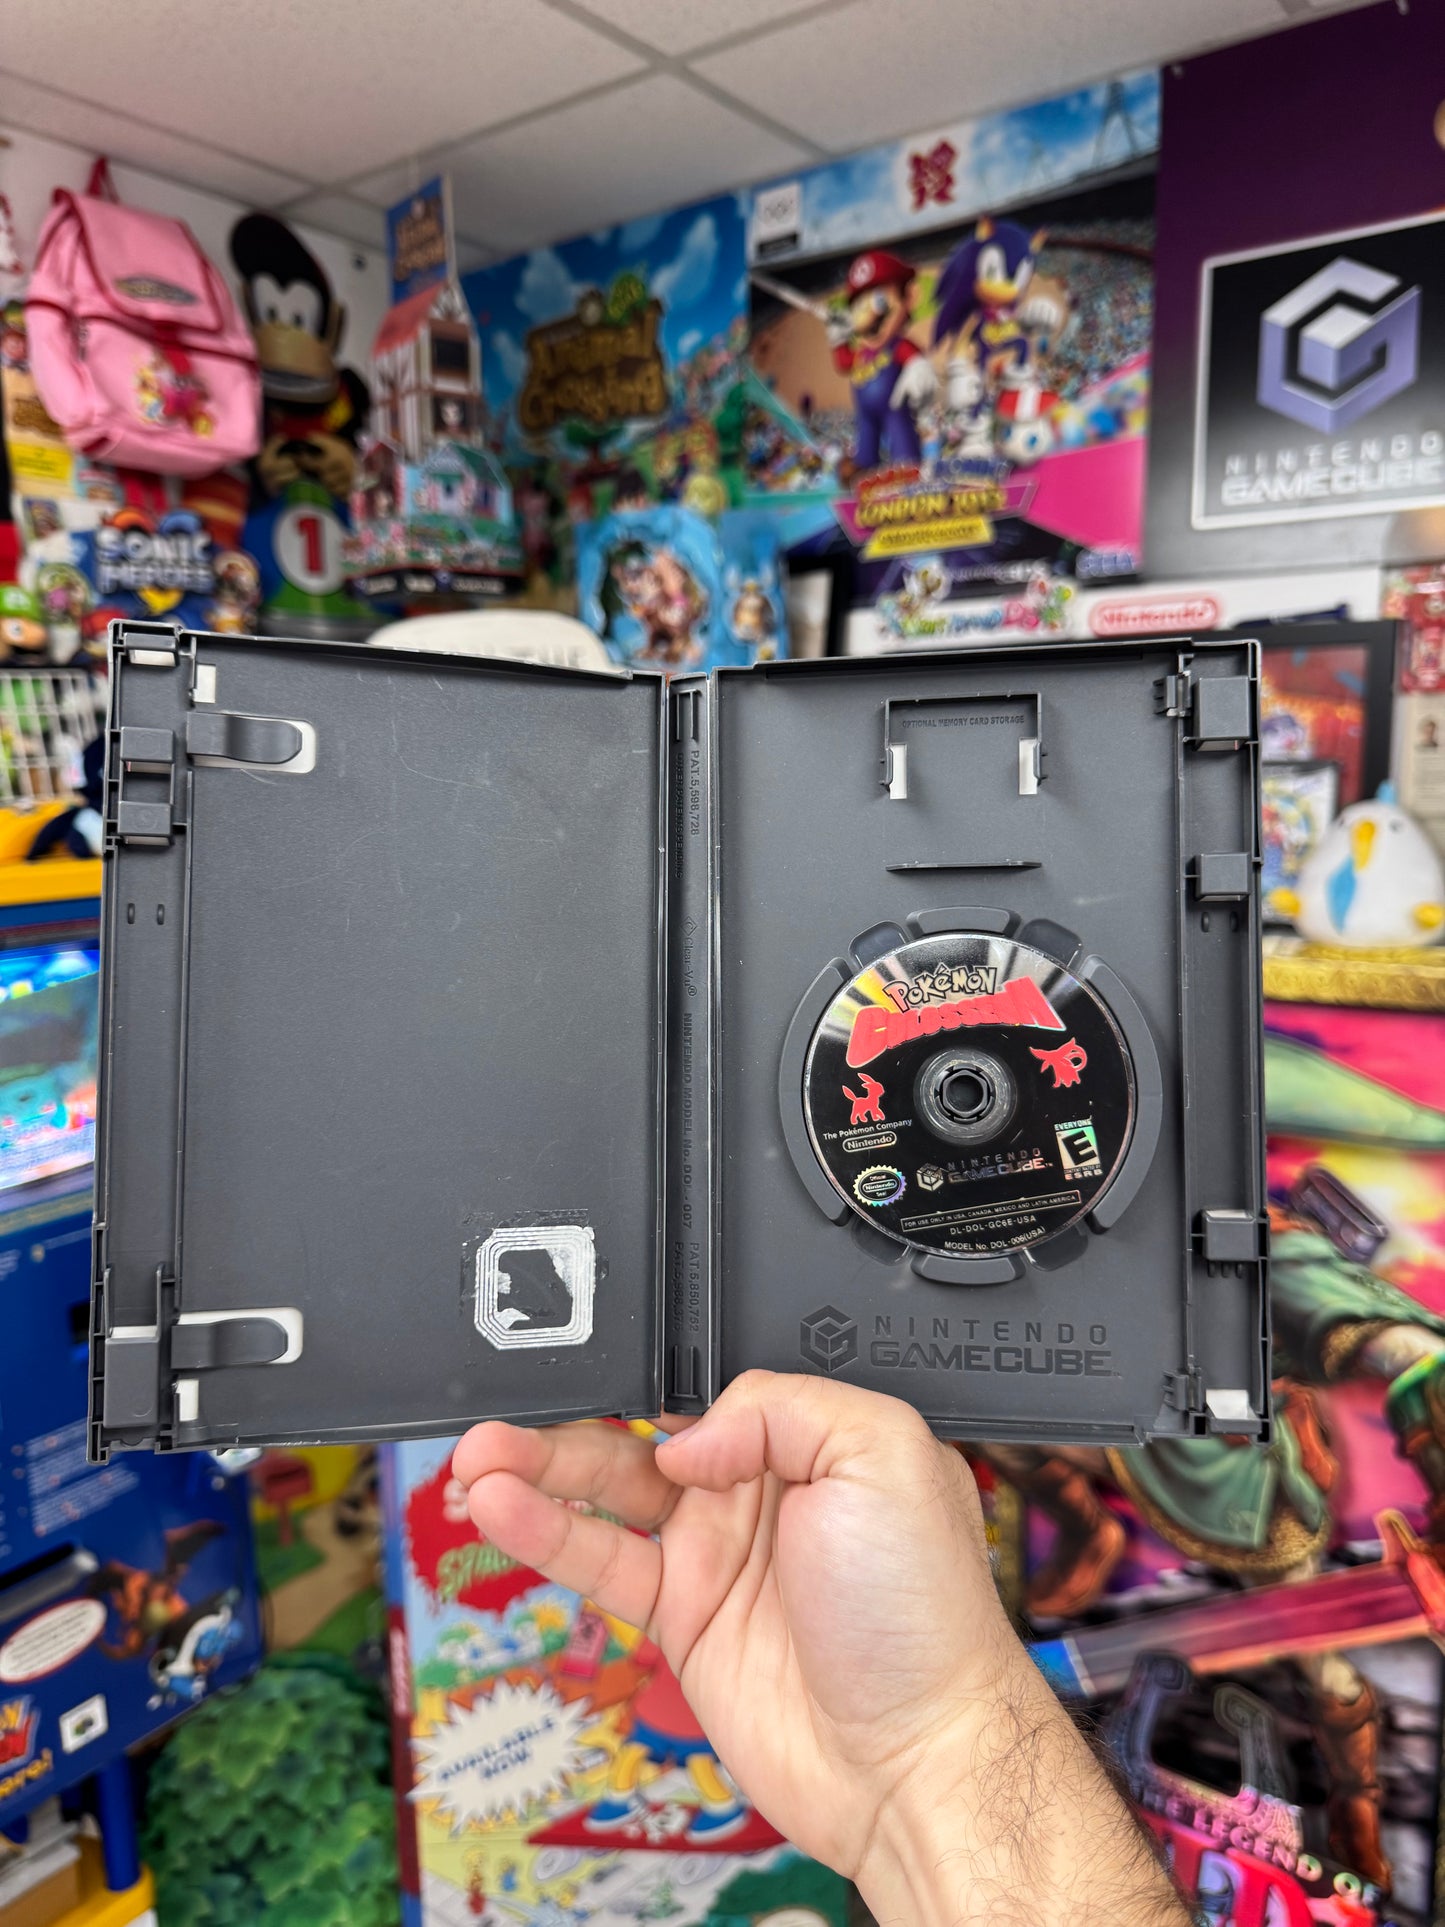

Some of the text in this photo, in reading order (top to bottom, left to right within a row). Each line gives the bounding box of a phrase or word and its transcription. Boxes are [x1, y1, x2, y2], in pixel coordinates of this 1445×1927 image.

[1226, 430, 1444, 475] NINTENDO
[1221, 455, 1443, 506] GAMECUBE
[297, 516, 323, 574] 1
[902, 715, 1025, 728] OPTIONAL MEMORY CARD STORAGE
[683, 1012, 693, 1084] NINTENDO
[683, 1087, 693, 1135] MODEL
[823, 1132, 838, 1141] The
[876, 1119, 913, 1132] Company
[1061, 1130, 1097, 1166] E
[947, 1147, 1041, 1171] NINTENDO
[1064, 1169, 1103, 1180] ESRB
[994, 1204, 1017, 1213] MEXICO
[1049, 1195, 1076, 1204] AMERICA
[944, 1241, 974, 1250] MODEL
[874, 1315, 1108, 1346] NINTENDO
[869, 1340, 1114, 1378] GAMECUBE
[1193, 1806, 1323, 1882] LEGEND
